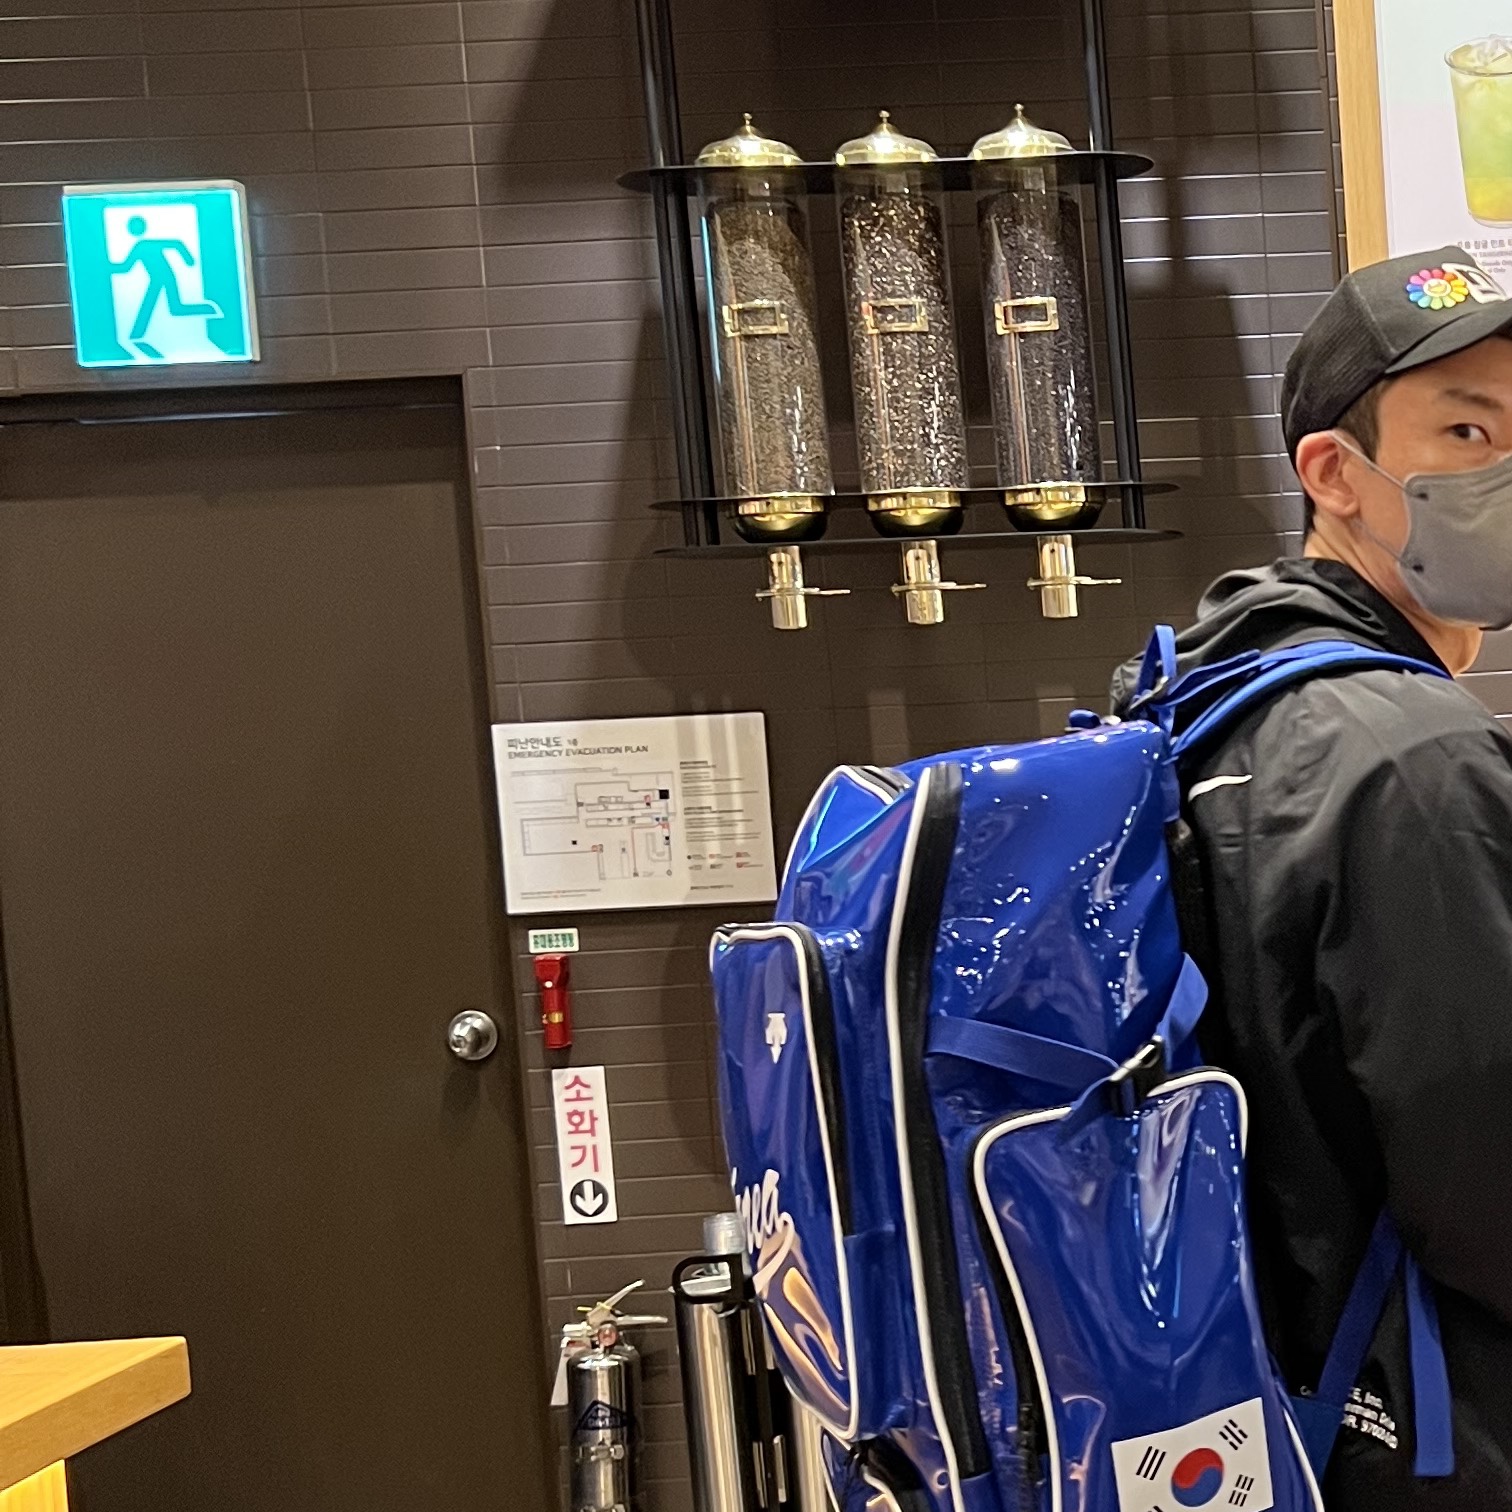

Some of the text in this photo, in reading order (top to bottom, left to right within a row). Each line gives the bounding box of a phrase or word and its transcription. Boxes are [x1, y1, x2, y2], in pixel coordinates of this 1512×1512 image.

[508, 745, 649, 759] EMERGENCY EVACUATION PLAN
[564, 1075, 600, 1173] 소화기
